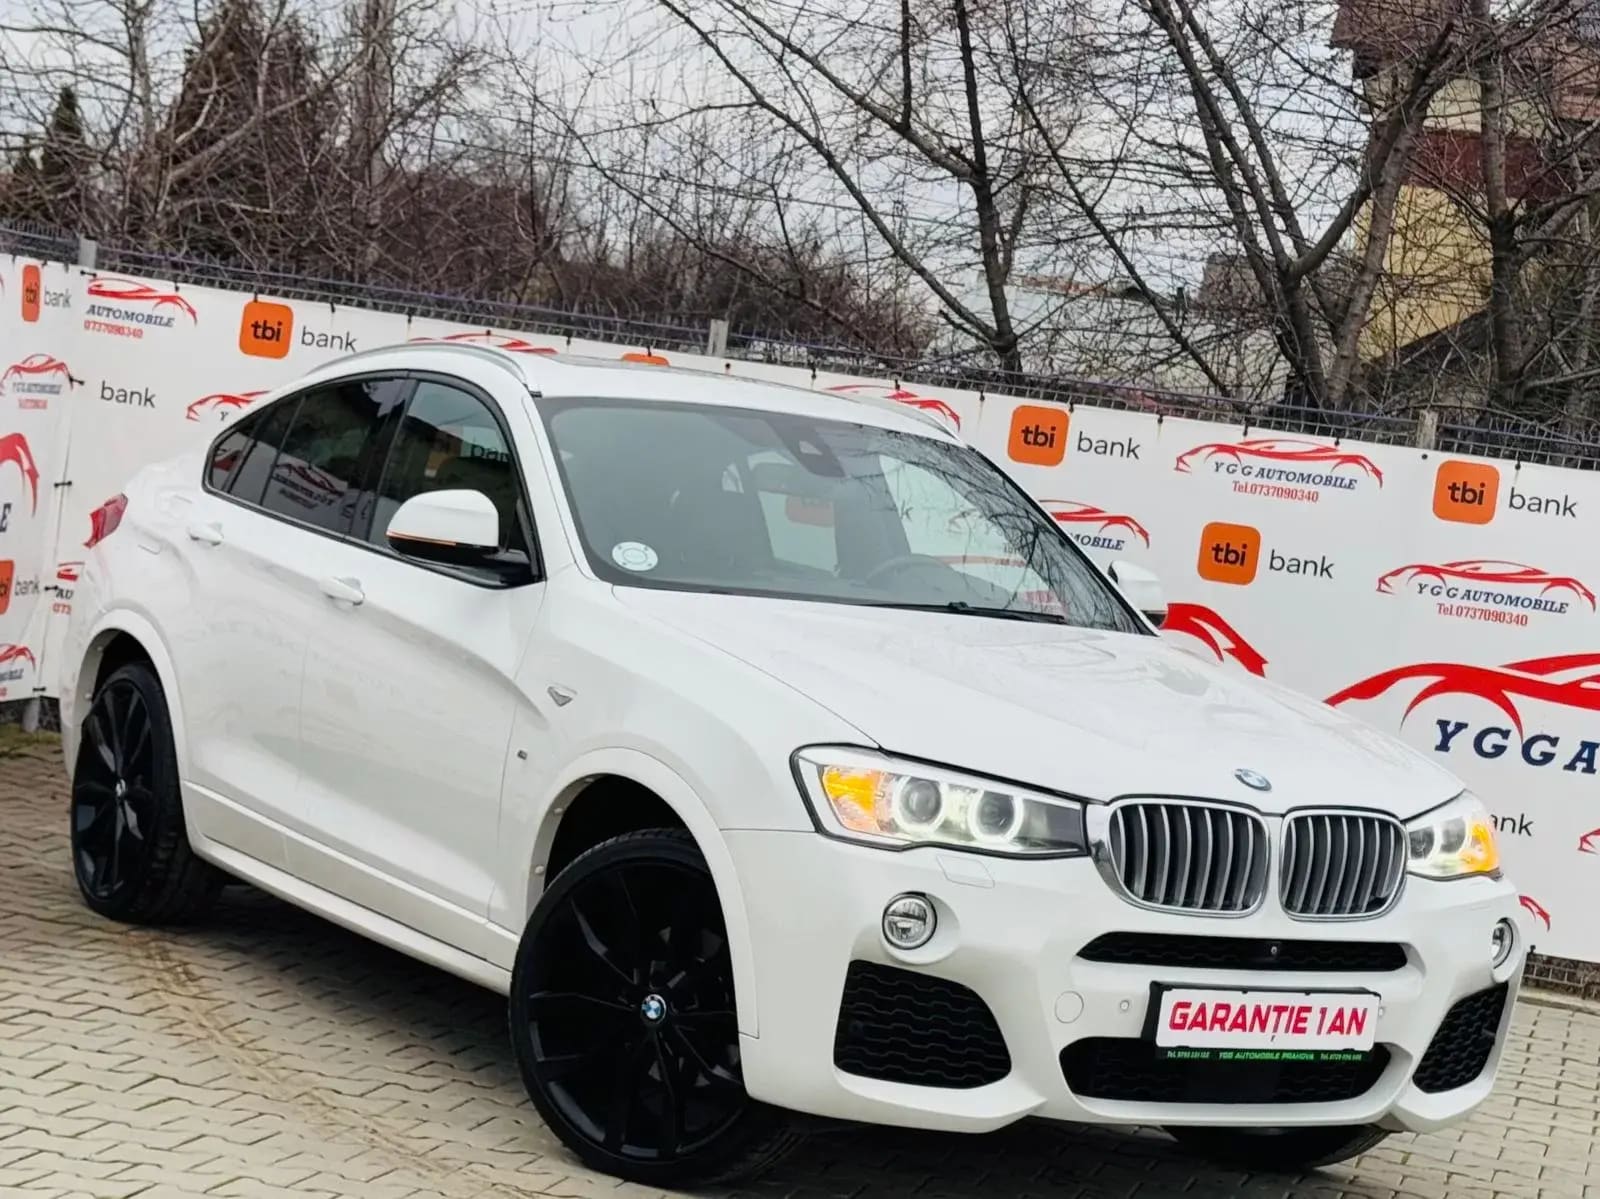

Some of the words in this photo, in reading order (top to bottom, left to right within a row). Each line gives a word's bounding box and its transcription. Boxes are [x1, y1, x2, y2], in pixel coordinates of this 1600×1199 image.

[251, 320, 283, 342] tbi
[301, 326, 357, 352] bank
[100, 380, 155, 408] bank
[1021, 425, 1057, 449] tbi
[1077, 430, 1141, 460] bank
[1255, 467, 1358, 490] AUTOMOBILE
[1447, 481, 1486, 506] tbi
[1508, 486, 1577, 518] bank
[1211, 543, 1248, 567] tbi
[1269, 548, 1334, 579] bank
[1461, 589, 1569, 614] AUTOMOBILE
[1327, 1007, 1368, 1036] AN
